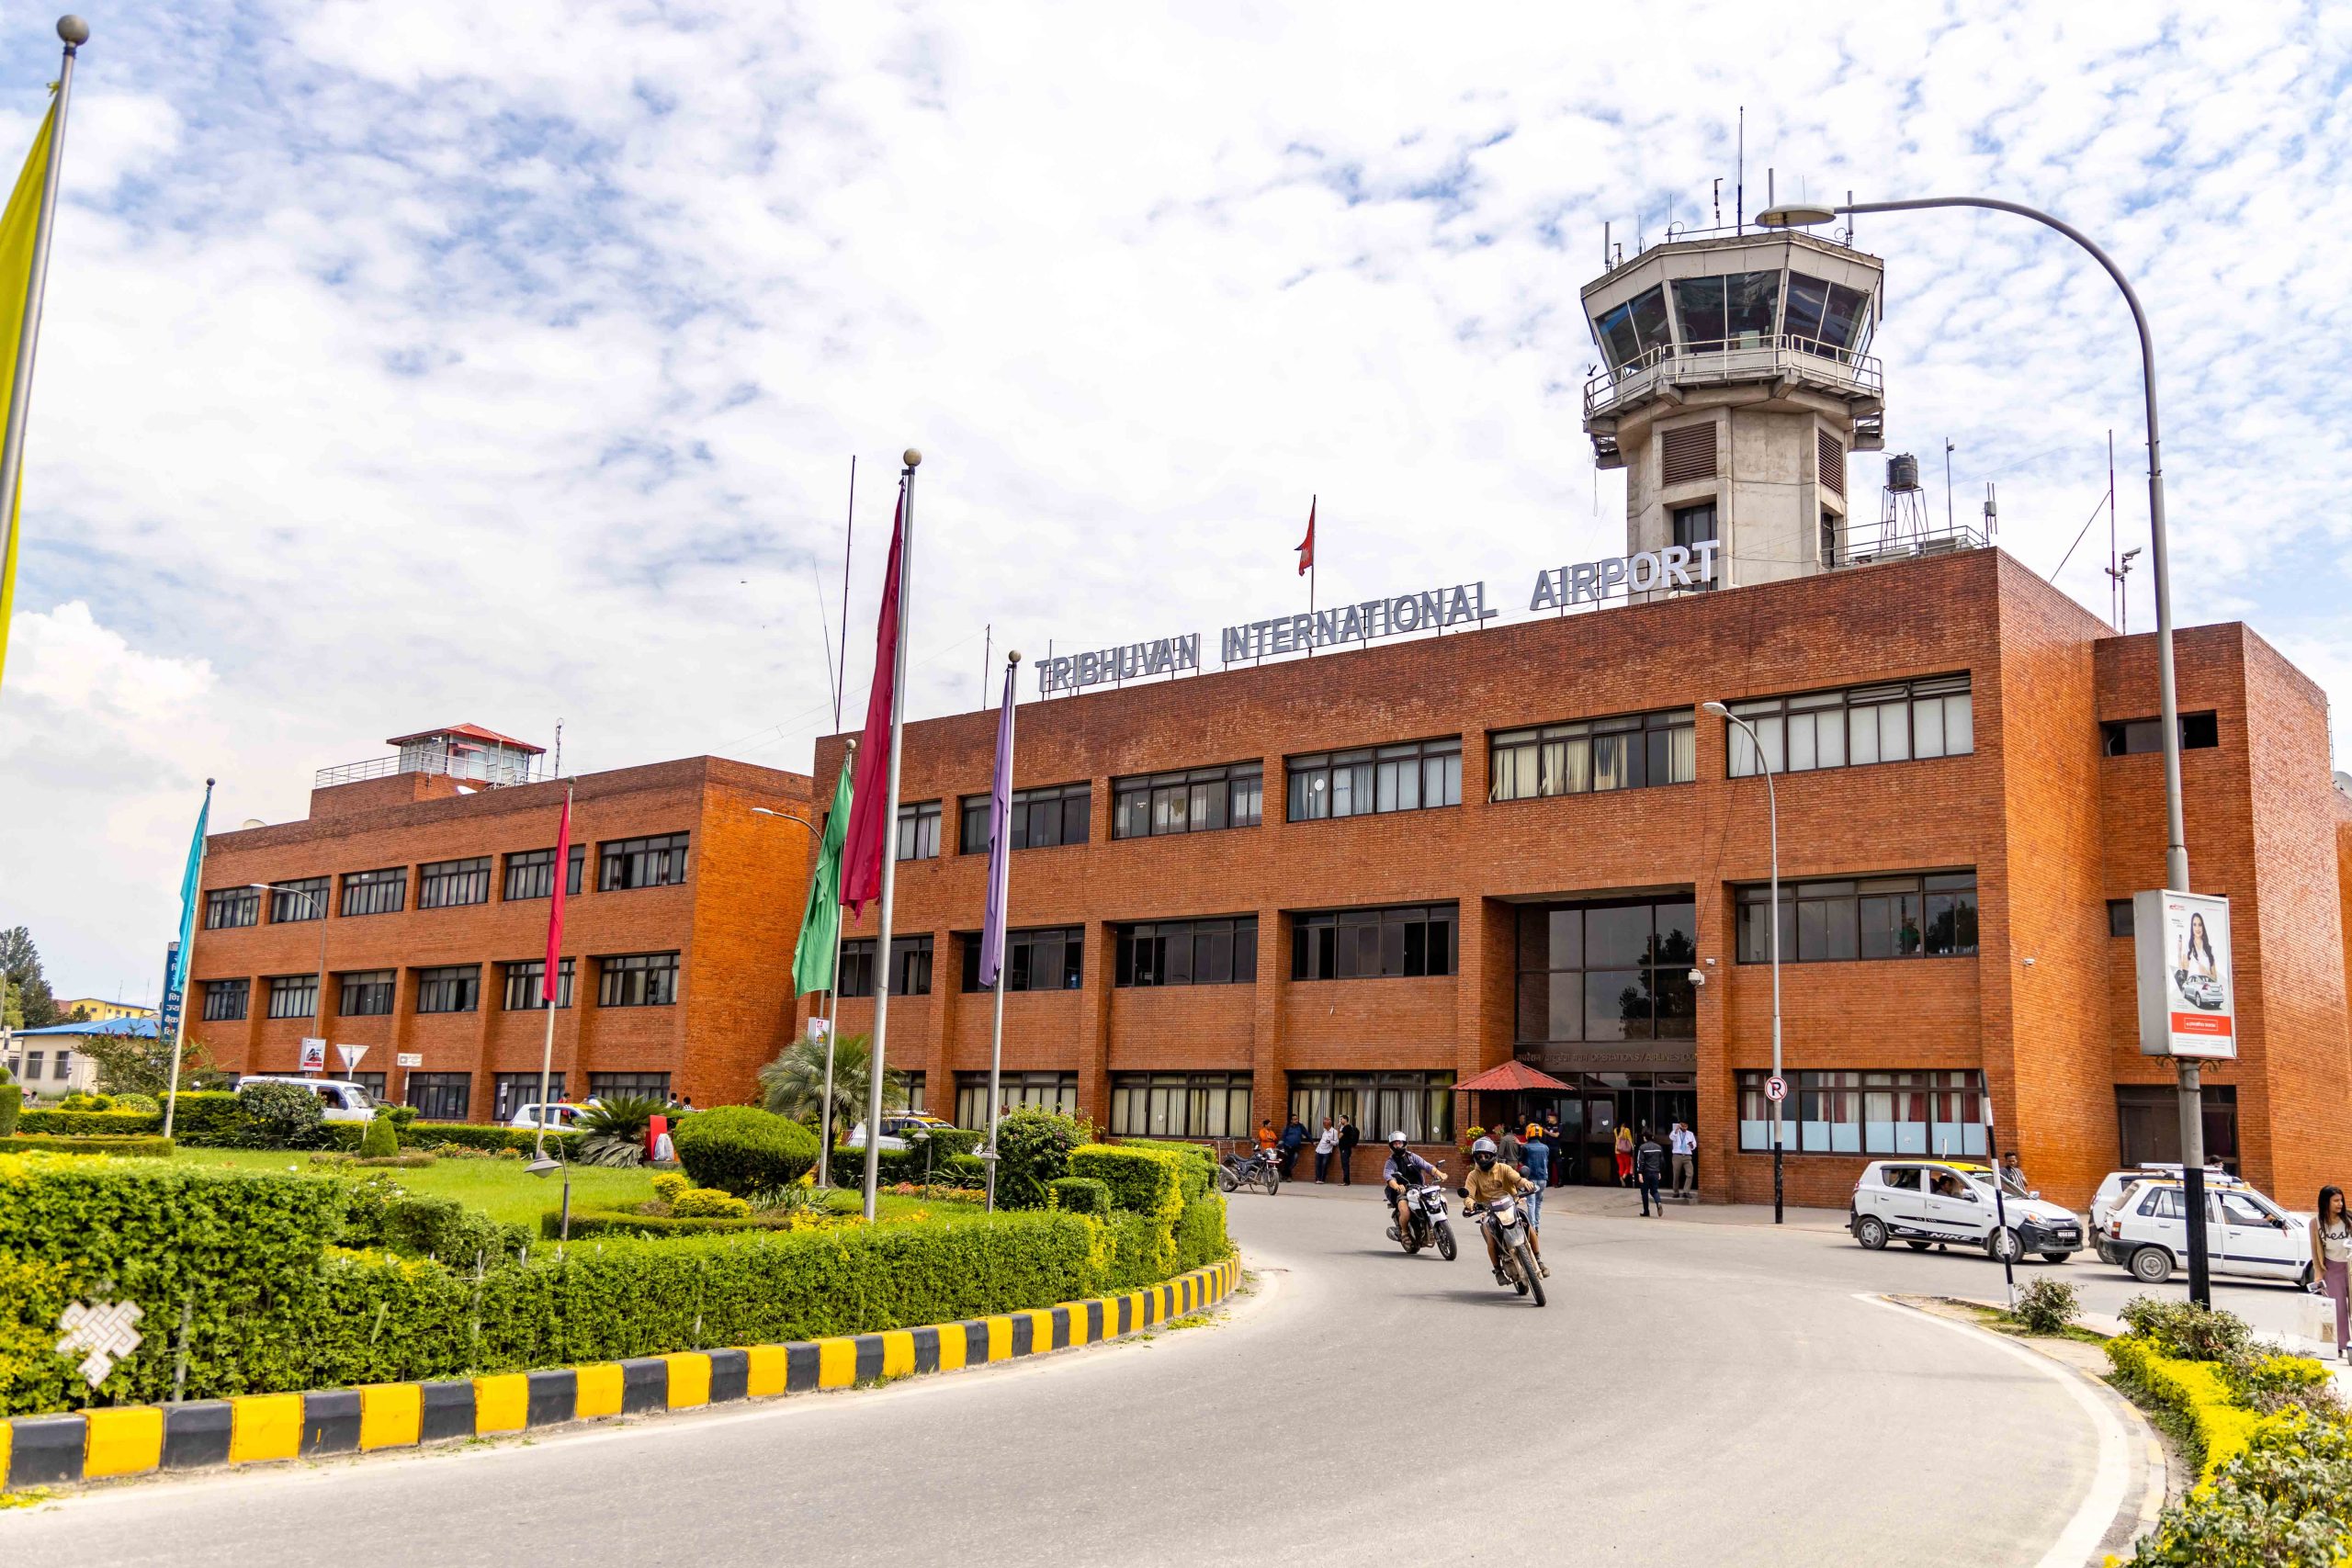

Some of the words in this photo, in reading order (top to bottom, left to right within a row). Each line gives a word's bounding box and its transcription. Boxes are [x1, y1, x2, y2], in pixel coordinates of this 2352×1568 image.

[1035, 632, 1200, 693] TRIBHUVAN
[1222, 581, 1499, 662] INTERNATIONAL
[1530, 539, 1721, 611] AIRPORT
[1771, 1081, 1782, 1097] P
[1929, 1232, 1973, 1241] NIKE
